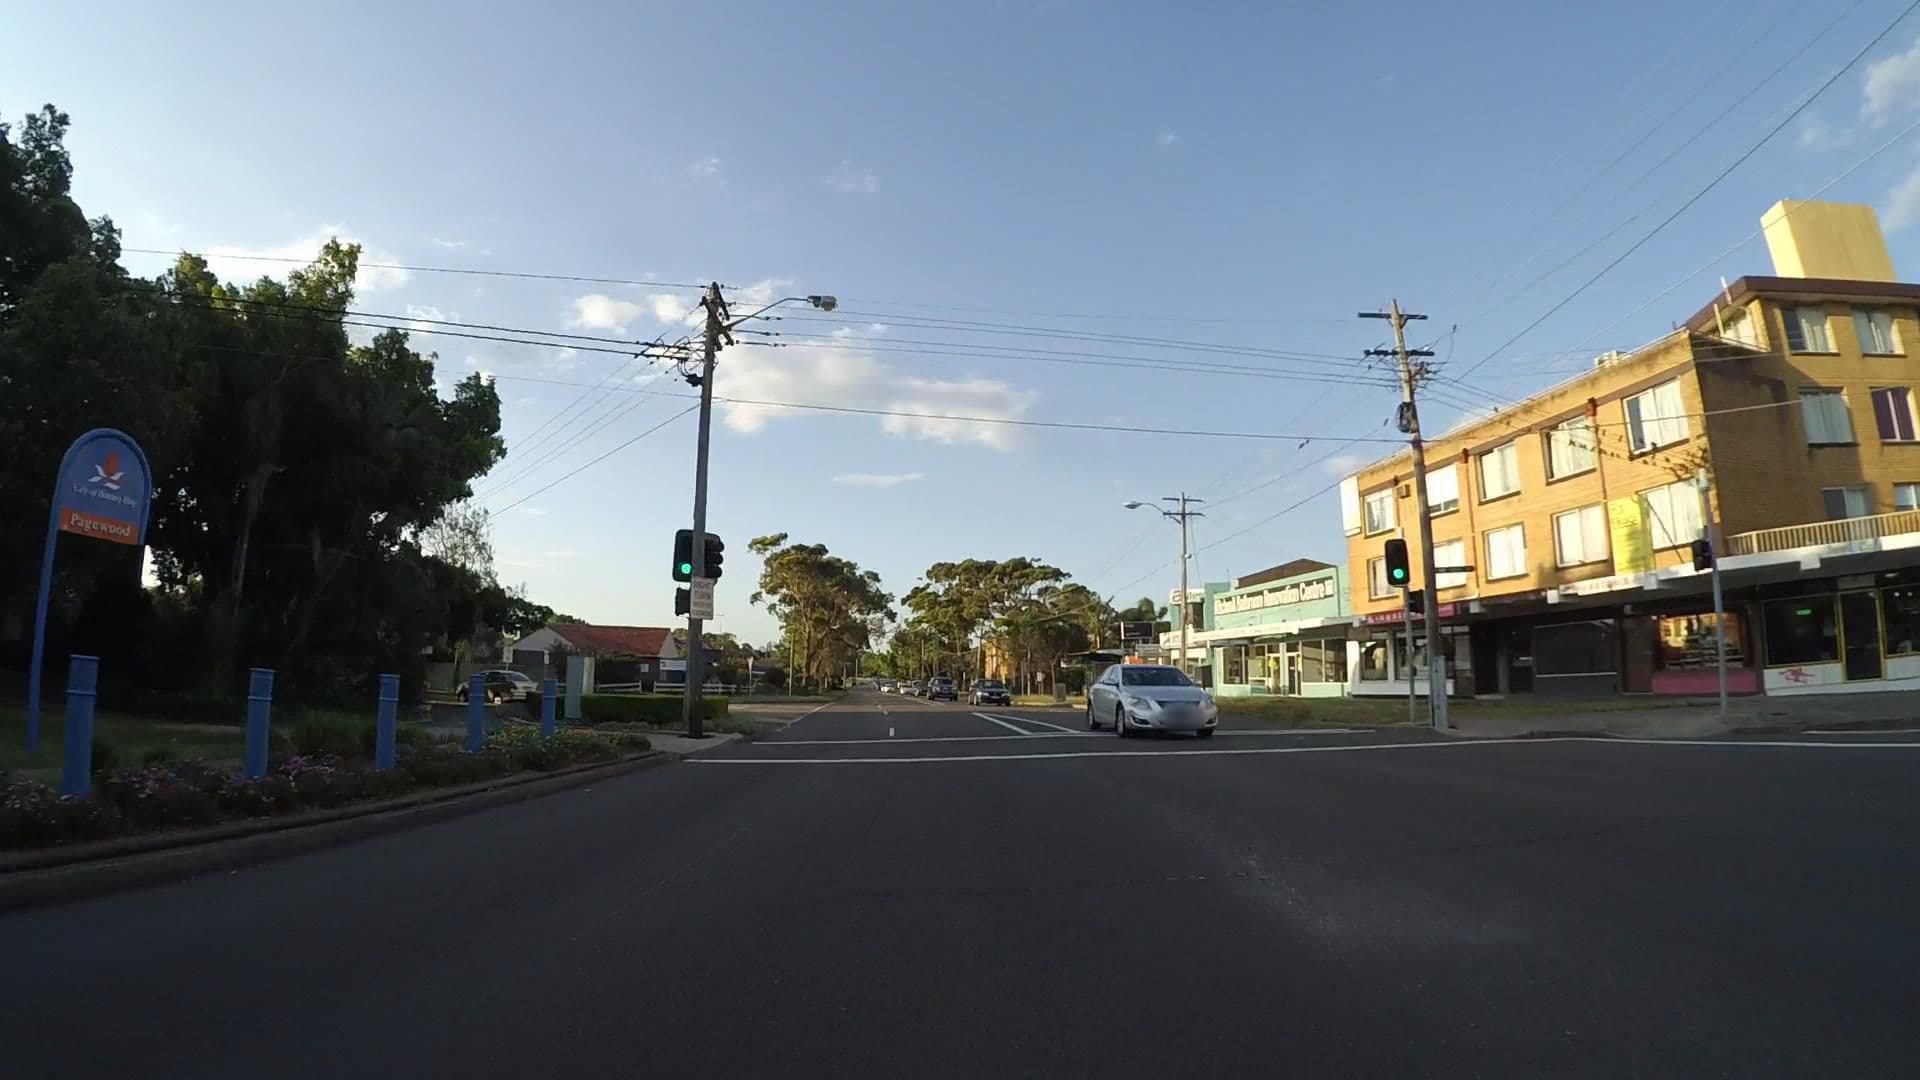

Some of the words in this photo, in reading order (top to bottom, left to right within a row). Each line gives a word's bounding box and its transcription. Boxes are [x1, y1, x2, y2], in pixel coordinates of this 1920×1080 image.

[73, 483, 88, 495] City
[98, 488, 122, 504] Botany
[123, 496, 137, 510] Bay
[70, 512, 131, 537] Pagewood
[1299, 581, 1324, 601] Centre
